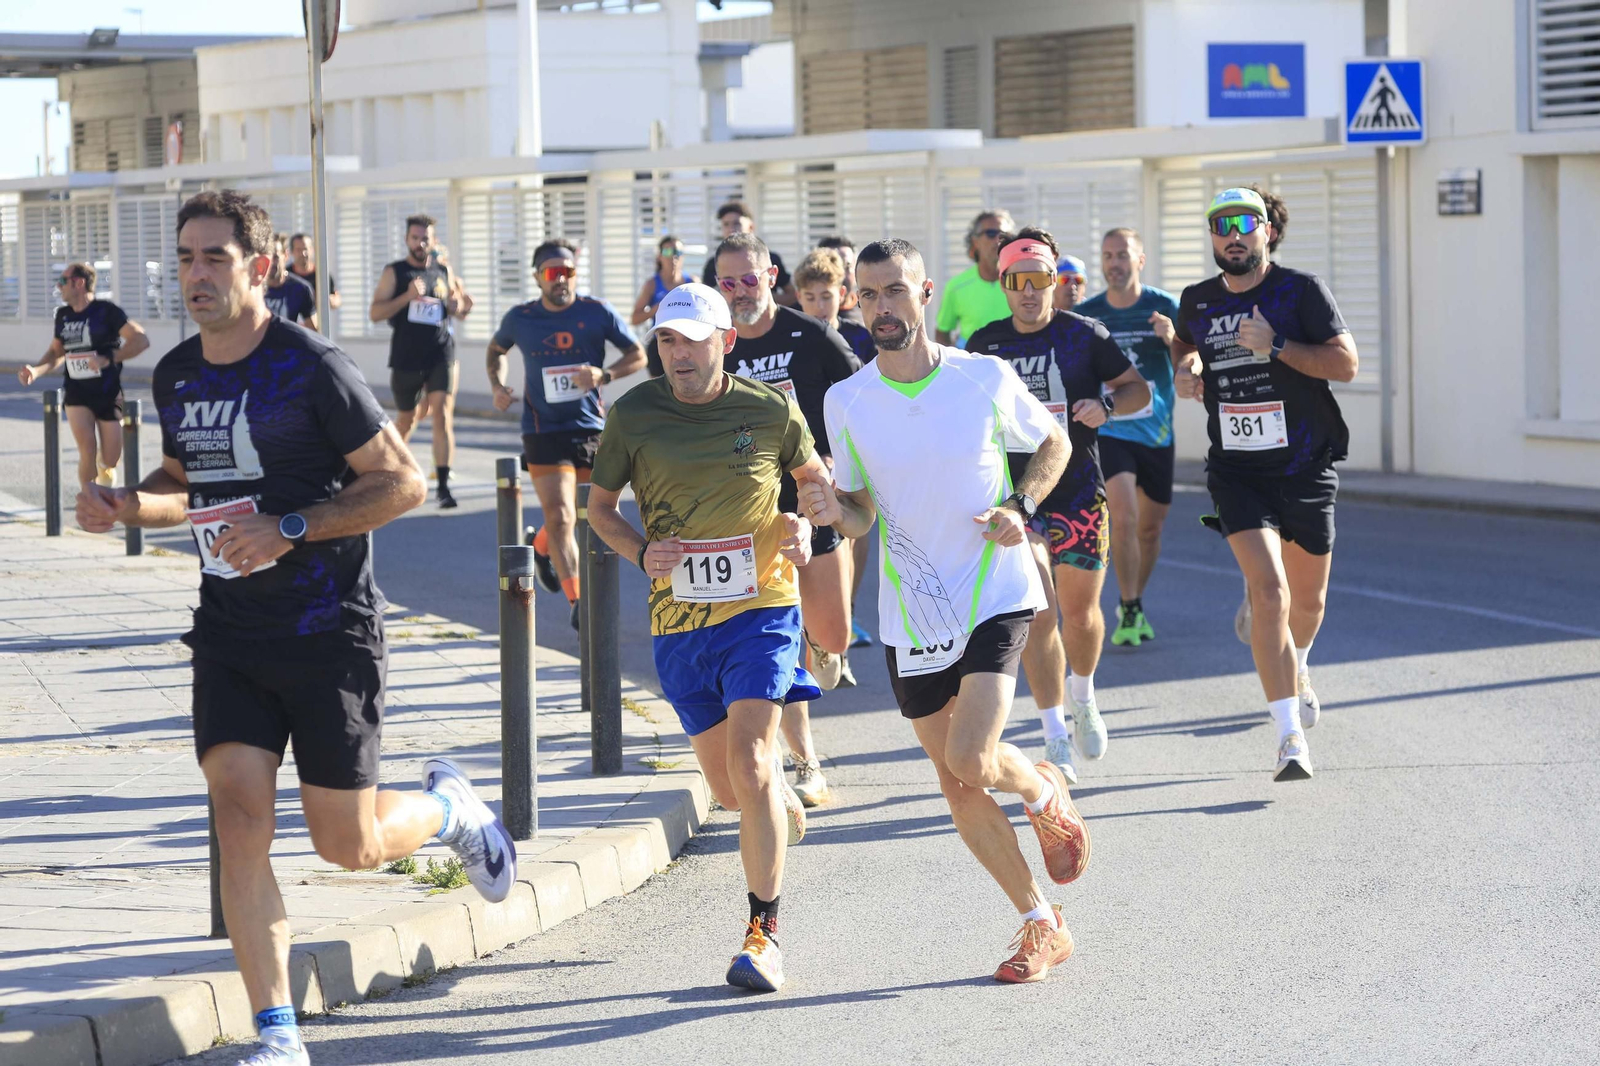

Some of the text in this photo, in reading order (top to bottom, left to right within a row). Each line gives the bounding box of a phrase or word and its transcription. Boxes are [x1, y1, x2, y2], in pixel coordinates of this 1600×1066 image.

[1207, 312, 1250, 336] XV
[1204, 333, 1234, 345] CARRERA
[751, 351, 794, 374] XIV
[751, 367, 785, 379] CARRERA
[1032, 374, 1046, 383] DEL
[179, 400, 236, 429] XVI
[1229, 415, 1264, 437] 361
[176, 429, 230, 443] CARRERA DEL
[185, 440, 230, 452] ESTRECHO
[196, 453, 230, 461] MEMORIAL
[186, 458, 234, 469] PEPE SERRANO
[683, 555, 732, 585] 119
[916, 579, 921, 589] 2
[935, 585, 942, 596] 3
